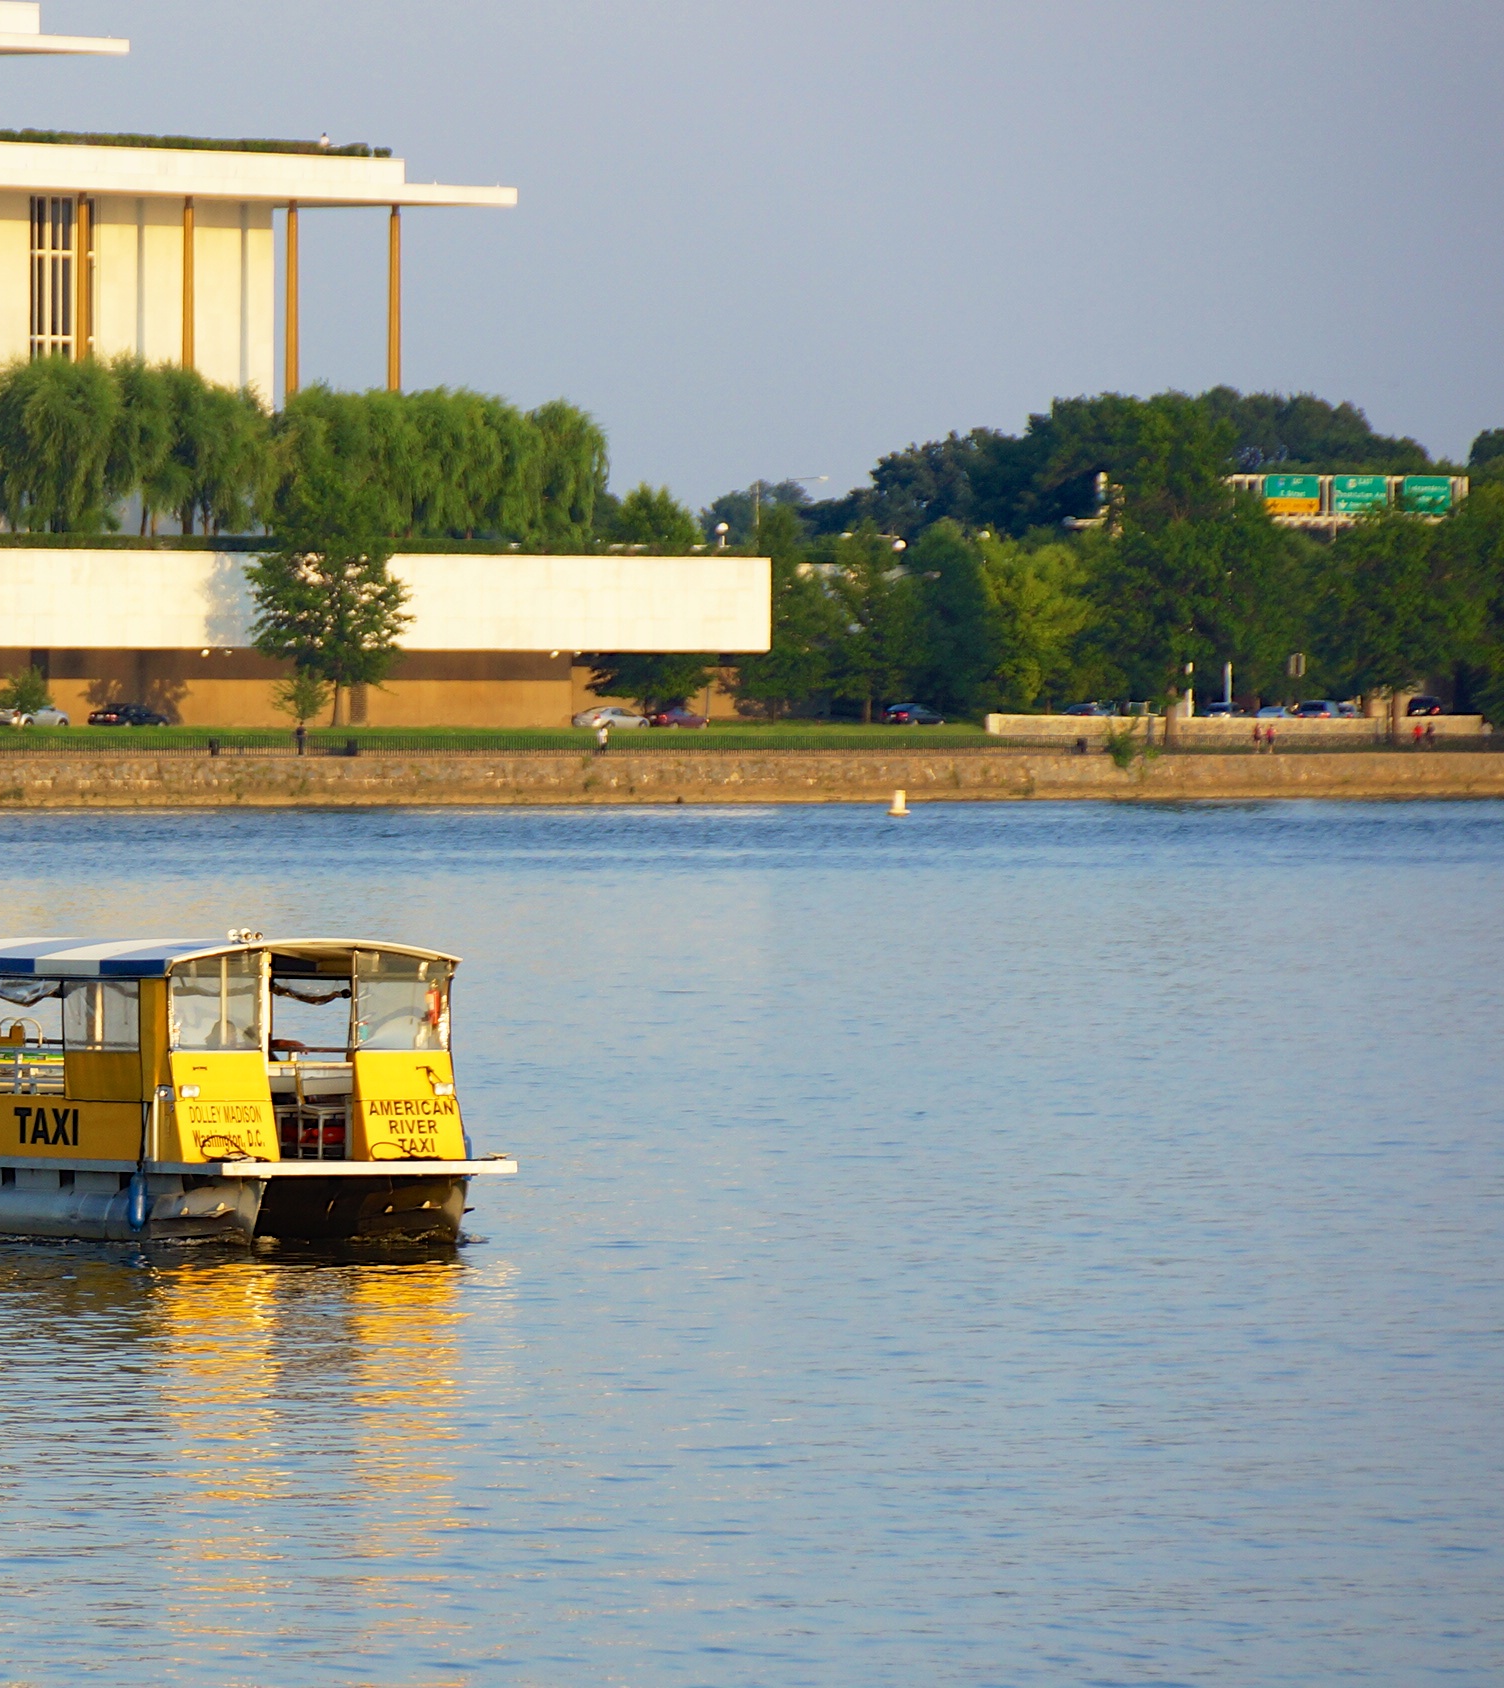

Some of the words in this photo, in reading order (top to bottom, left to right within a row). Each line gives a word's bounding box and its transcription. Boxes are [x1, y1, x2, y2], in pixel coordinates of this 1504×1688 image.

[189, 1106, 221, 1123] DOLLEY
[223, 1106, 262, 1123] MADISON
[369, 1100, 454, 1116] AMERICAN
[14, 1106, 79, 1146] TAXI
[389, 1120, 438, 1134] RIVER
[247, 1130, 265, 1147] D.C.
[398, 1138, 435, 1153] TAXI
